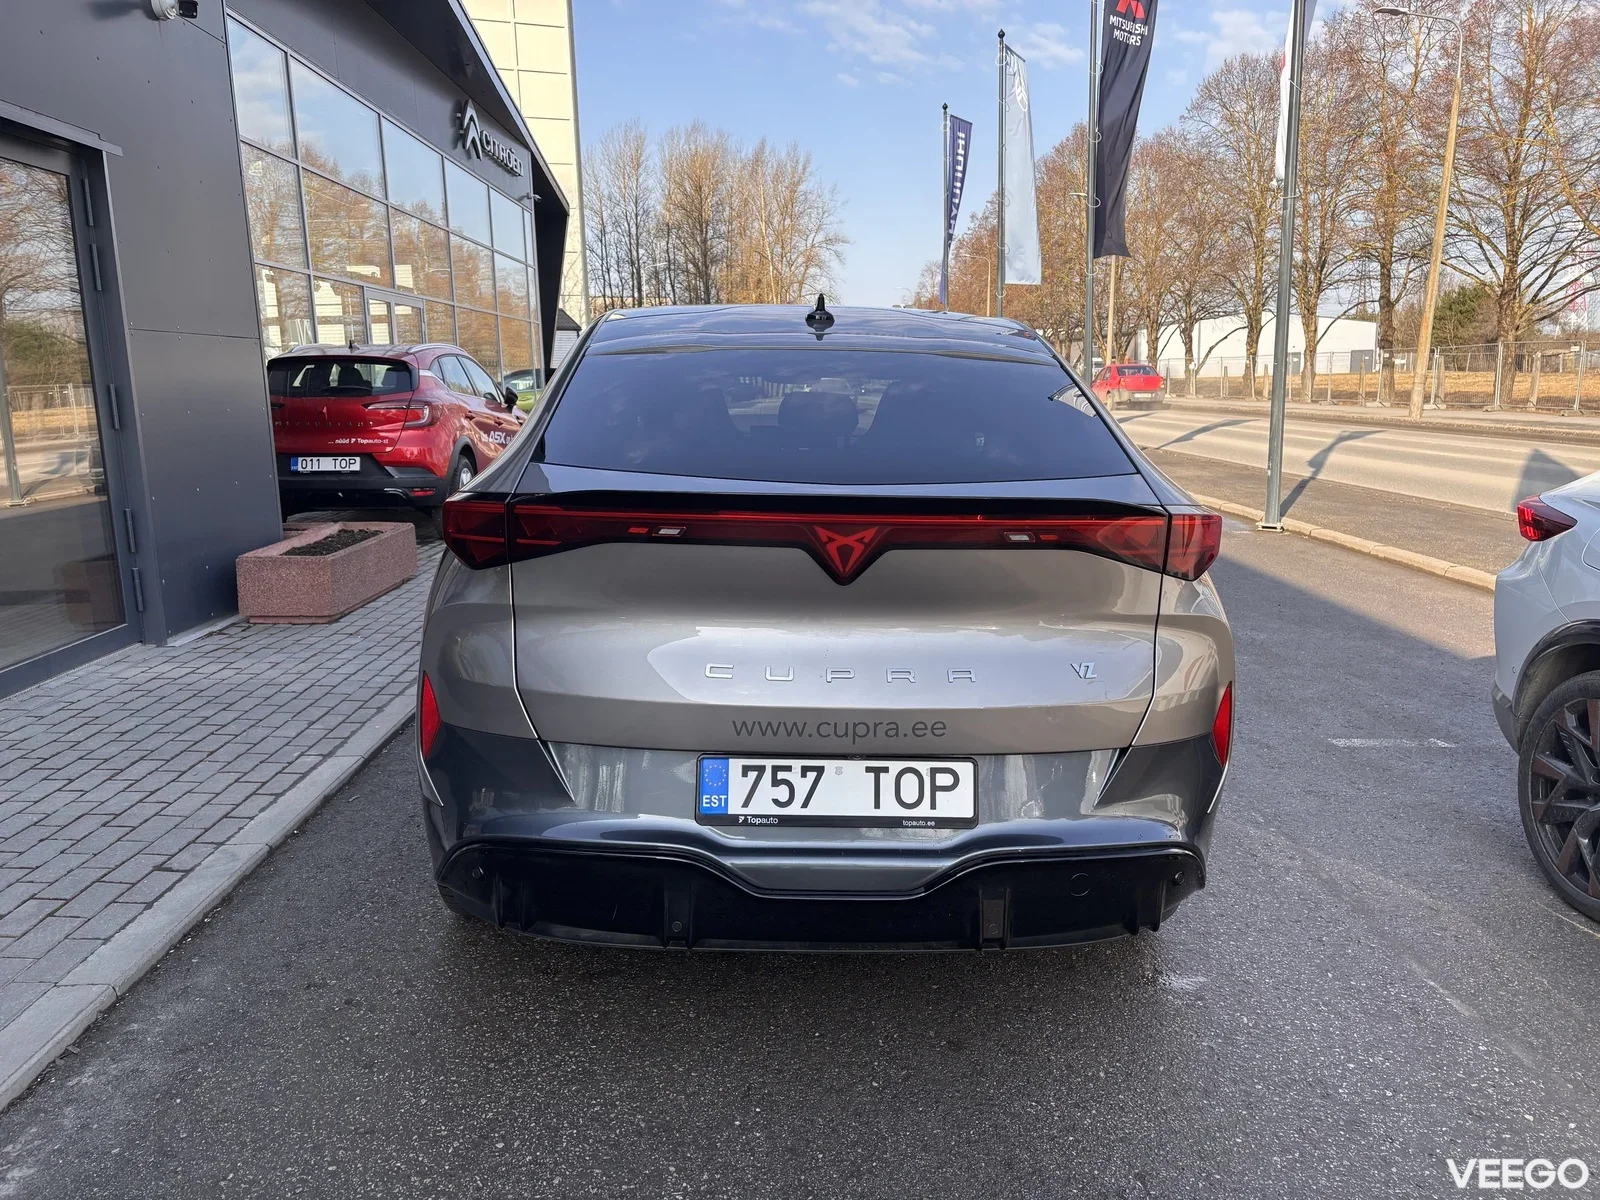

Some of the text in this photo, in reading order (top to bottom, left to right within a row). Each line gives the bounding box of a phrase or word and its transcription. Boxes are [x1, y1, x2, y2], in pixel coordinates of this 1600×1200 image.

[489, 431, 506, 444] ASX
[300, 458, 321, 470] 011
[332, 458, 357, 470] TOP
[705, 663, 977, 684] CUPRA
[732, 719, 947, 745] www.cupra.ee
[741, 764, 960, 810] 757 TOP
[702, 794, 727, 807] EST
[747, 816, 779, 825] Topauto
